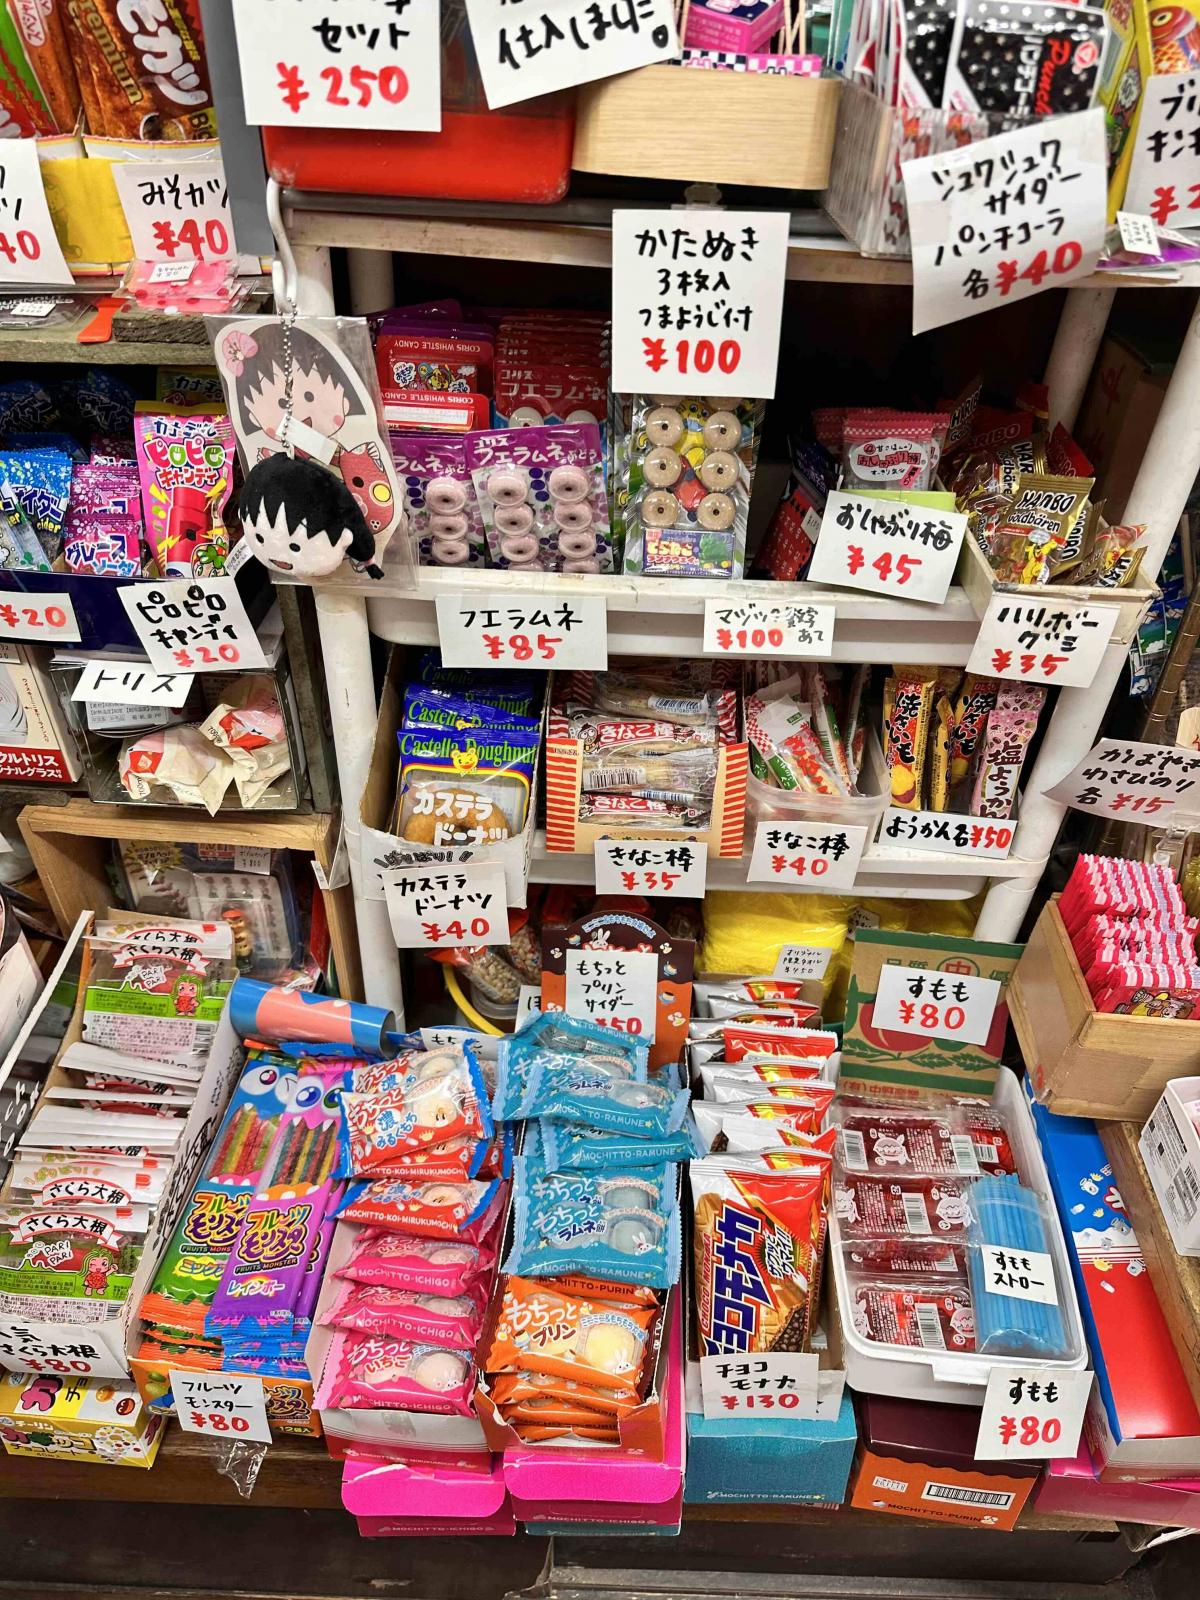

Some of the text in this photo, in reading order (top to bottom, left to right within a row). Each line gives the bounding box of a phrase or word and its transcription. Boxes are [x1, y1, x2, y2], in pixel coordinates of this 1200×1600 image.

[313, 17, 410, 54] セット
[498, 0, 669, 70] 仕入しました。
[277, 62, 410, 113] ¥250
[138, 174, 228, 209] みそカツ
[984, 164, 1083, 215] サイダー
[152, 219, 230, 261] ¥40
[634, 226, 759, 262] かたぬき
[934, 208, 1066, 266] パンチコーラ
[657, 268, 730, 296] 3枚入
[639, 299, 753, 331] つまようじ付
[641, 337, 742, 374] ¥100
[143, 436, 225, 468] ピロピロ
[474, 434, 510, 450] コリス
[474, 445, 568, 467] フエラムネ
[157, 467, 220, 489] キャンディ
[835, 503, 953, 551] おしゃぶり梅
[847, 544, 922, 584] ¥45
[0, 605, 67, 628] ¥20
[137, 585, 227, 624] ピロピロ
[459, 602, 584, 633] フエラムネ
[150, 613, 238, 648] キャンディ
[997, 607, 1099, 632] ハリボー
[483, 633, 563, 661] ¥85
[716, 628, 783, 650] ¥100
[798, 628, 824, 644] あて
[1017, 631, 1080, 652] グミ
[172, 643, 241, 667] ¥20
[991, 648, 1069, 675] ¥35
[92, 669, 177, 693] トリス
[600, 722, 675, 742] きなこ棒
[888, 691, 922, 763] 焼きいも
[950, 692, 997, 756] 焼きいも
[979, 741, 1022, 820] 塩ようかん
[1082, 767, 1195, 793] わさびのり
[412, 789, 494, 821] カステラ
[593, 795, 668, 811] きなこ棒
[767, 829, 850, 861] きなこ棒
[608, 846, 695, 873] きなこ棒
[771, 855, 829, 876] ¥40
[394, 873, 468, 897] カステラ
[620, 870, 682, 891] ¥35
[414, 892, 493, 917] ドーナツ
[421, 917, 490, 943] ¥40
[576, 960, 627, 976] もちっと
[581, 979, 628, 997] プリン
[906, 975, 970, 1002] すもも
[585, 995, 634, 1014] サイダー
[898, 999, 966, 1030] ¥80
[376, 1112, 418, 1150] みるくもち
[49, 1181, 126, 1205] さくら大根
[26, 1214, 108, 1236] さくら大根
[246, 1204, 312, 1230] フルーツ
[532, 1203, 600, 1232] もちっと
[44, 1240, 73, 1266] PARI PARI
[234, 1257, 298, 1275] FRUITS MONSTER
[991, 1250, 1033, 1271] すもも
[227, 1279, 286, 1296] レインボー
[357, 1267, 450, 1288] MOCHITTO-ICHIGO
[993, 1272, 1045, 1290] ストロー
[505, 1298, 578, 1330] もちっと
[702, 1287, 711, 1330] CHOCO
[532, 1322, 576, 1347] プリン
[346, 1338, 411, 1365] もちっと
[364, 1354, 413, 1375] いちご
[19, 1358, 92, 1373] ¥80
[715, 1362, 768, 1379] チョコ
[181, 1380, 243, 1394] フルーツ
[729, 1375, 797, 1392] モナカ
[1008, 1377, 1059, 1405] すもも
[184, 1395, 253, 1410] モンスター
[720, 1392, 800, 1410] ¥130
[190, 1412, 250, 1433] ¥80
[998, 1414, 1062, 1447] ¥80
[887, 1502, 982, 1523] MOCHITTO-PURIN
